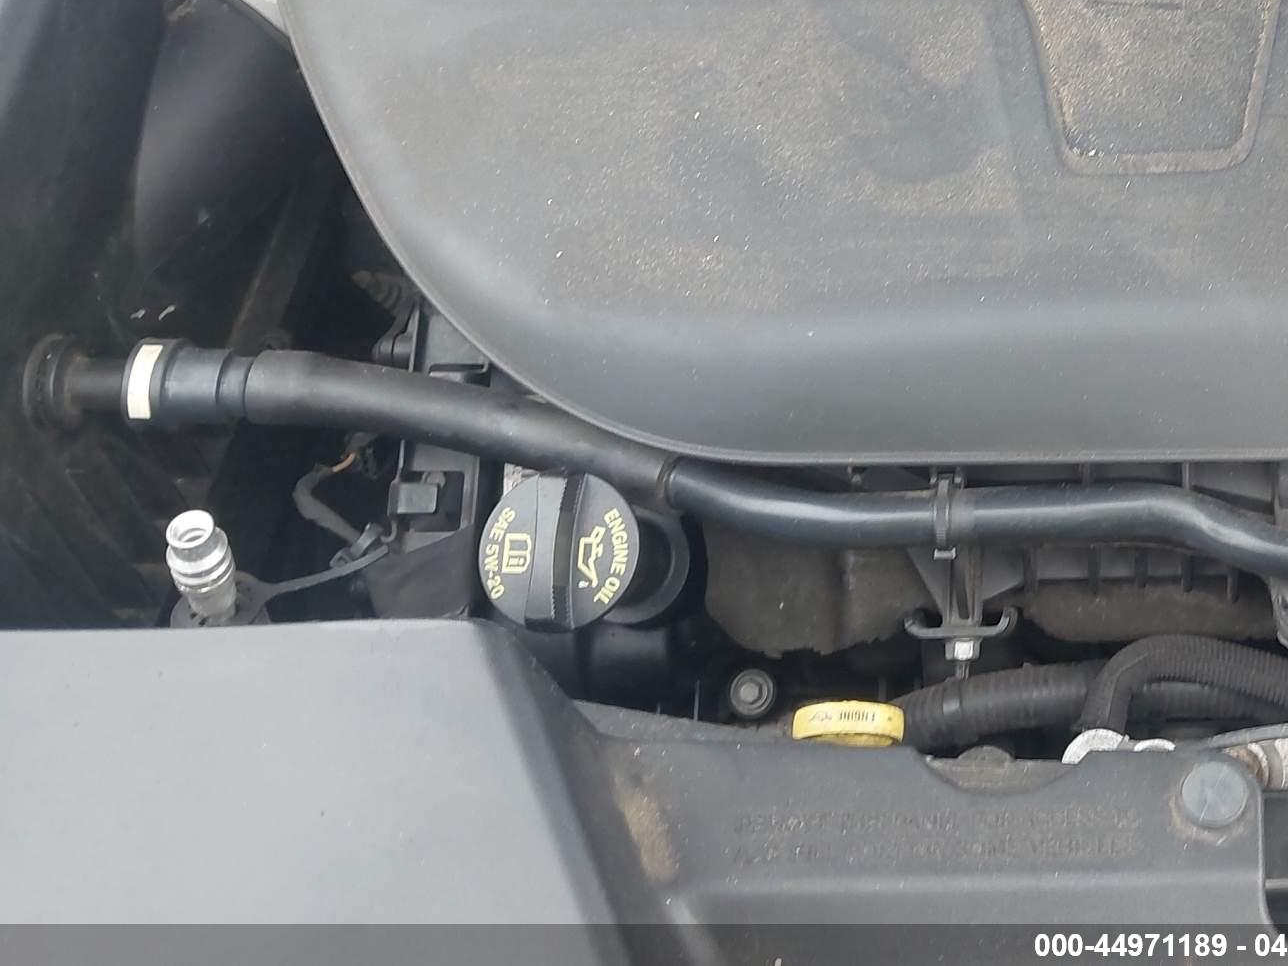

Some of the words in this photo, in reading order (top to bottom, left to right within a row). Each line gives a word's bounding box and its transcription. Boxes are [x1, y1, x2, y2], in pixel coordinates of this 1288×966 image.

[489, 507, 516, 542] SAE
[603, 508, 630, 576] ENGINE
[484, 543, 505, 600] 5W-20
[593, 576, 621, 604] OIL
